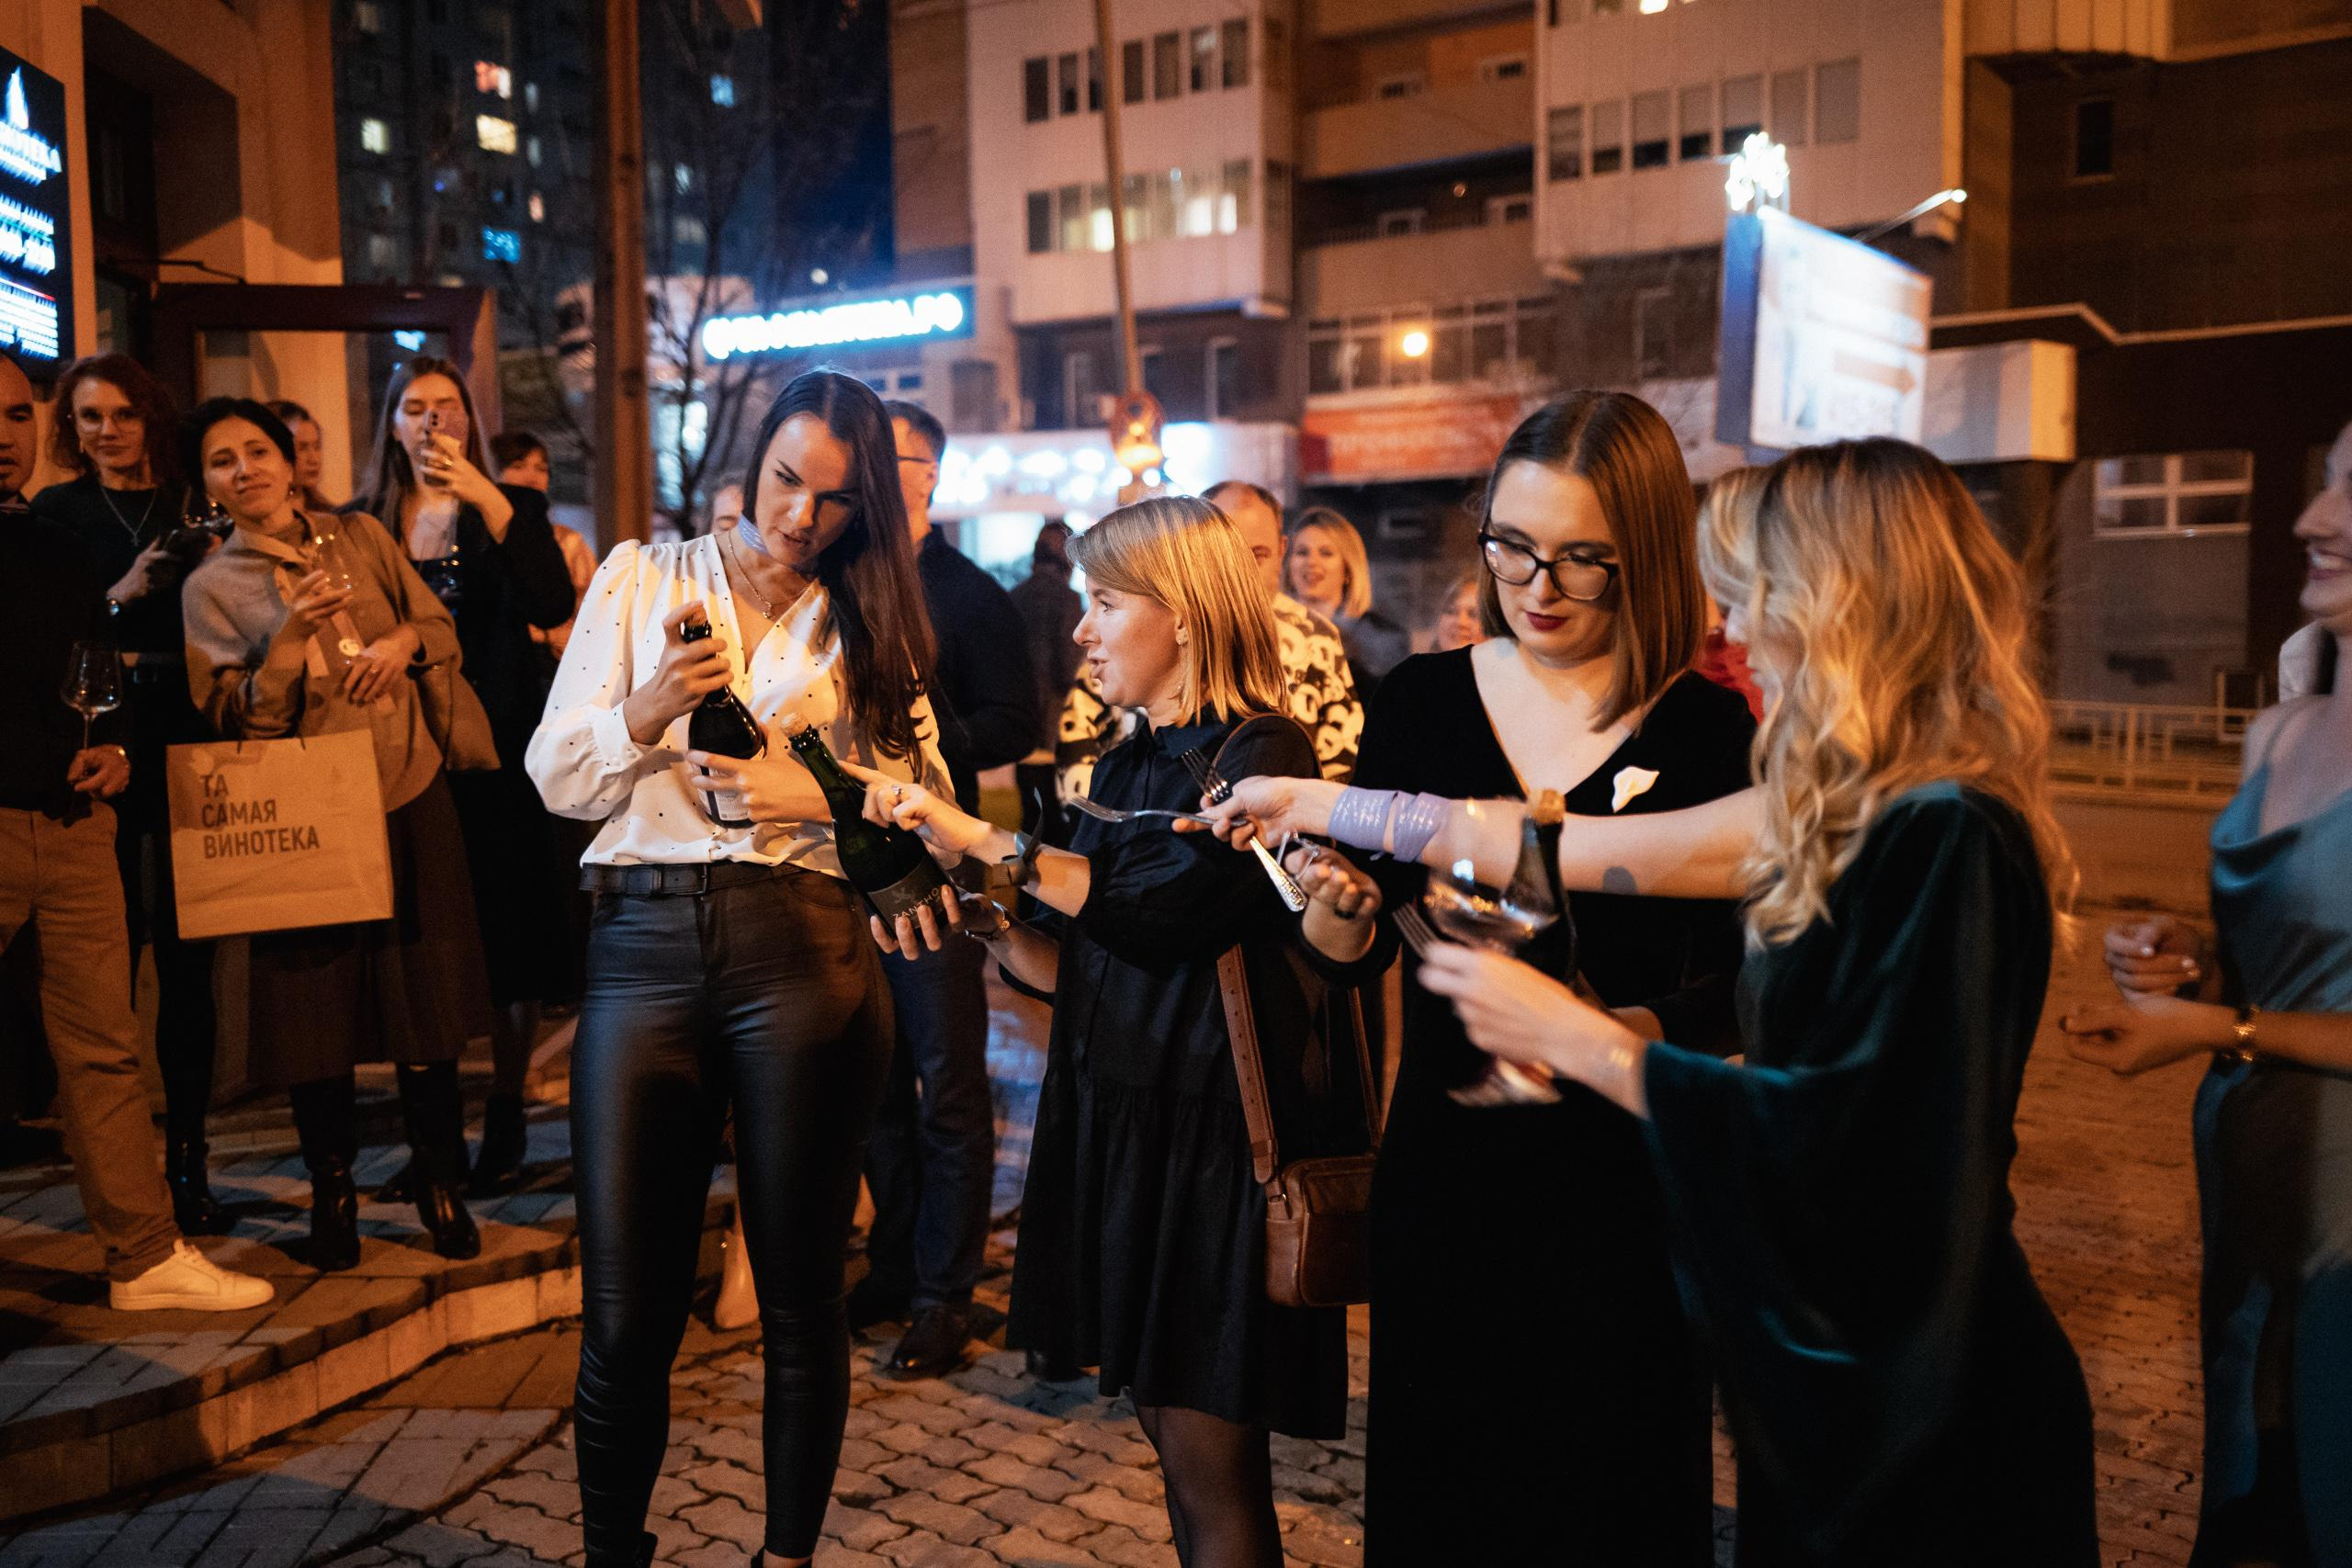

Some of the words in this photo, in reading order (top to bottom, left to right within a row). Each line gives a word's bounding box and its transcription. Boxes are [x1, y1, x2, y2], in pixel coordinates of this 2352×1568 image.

[200, 774, 229, 797] ТА
[202, 799, 277, 827] САМАЯ
[204, 826, 320, 859] ВИНОТЕКА
